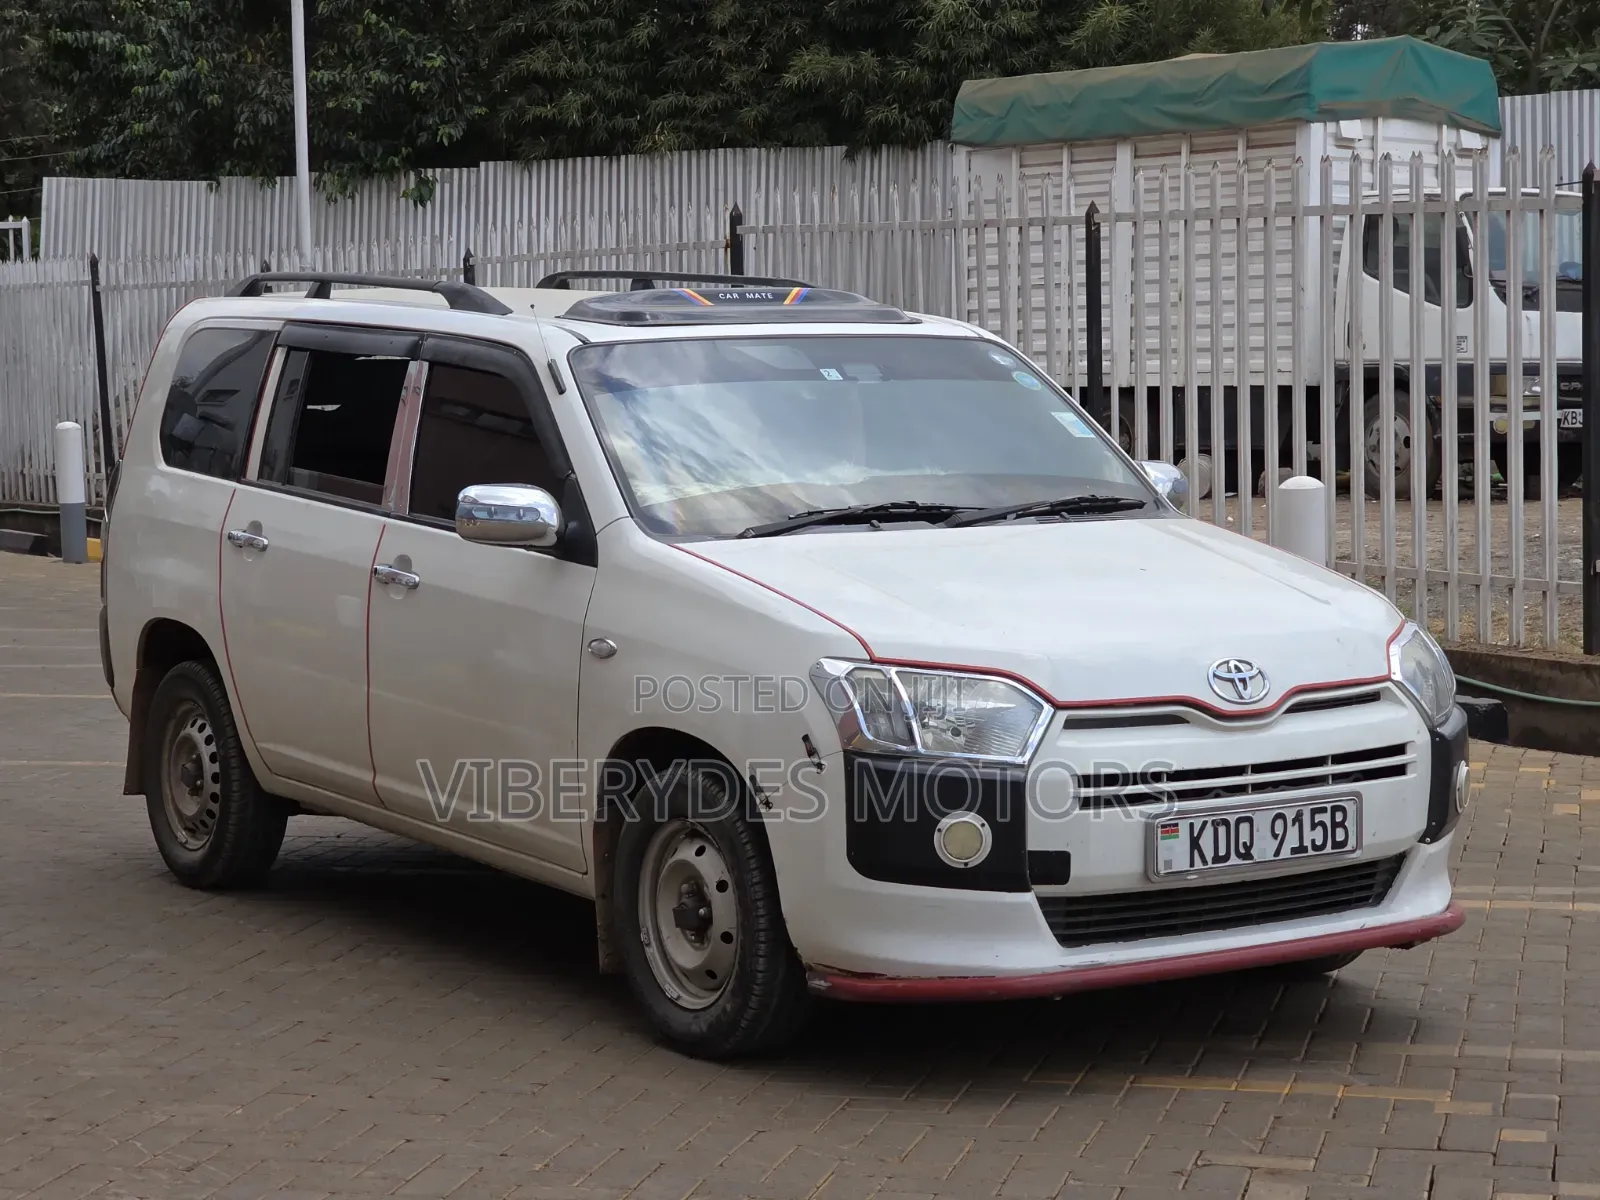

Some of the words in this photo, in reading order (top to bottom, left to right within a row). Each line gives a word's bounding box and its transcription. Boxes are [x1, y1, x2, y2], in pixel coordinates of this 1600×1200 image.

[718, 292, 740, 300] CAR
[745, 292, 774, 300] MATE
[1188, 815, 1255, 868] KDQ
[1270, 804, 1349, 858] 915B
